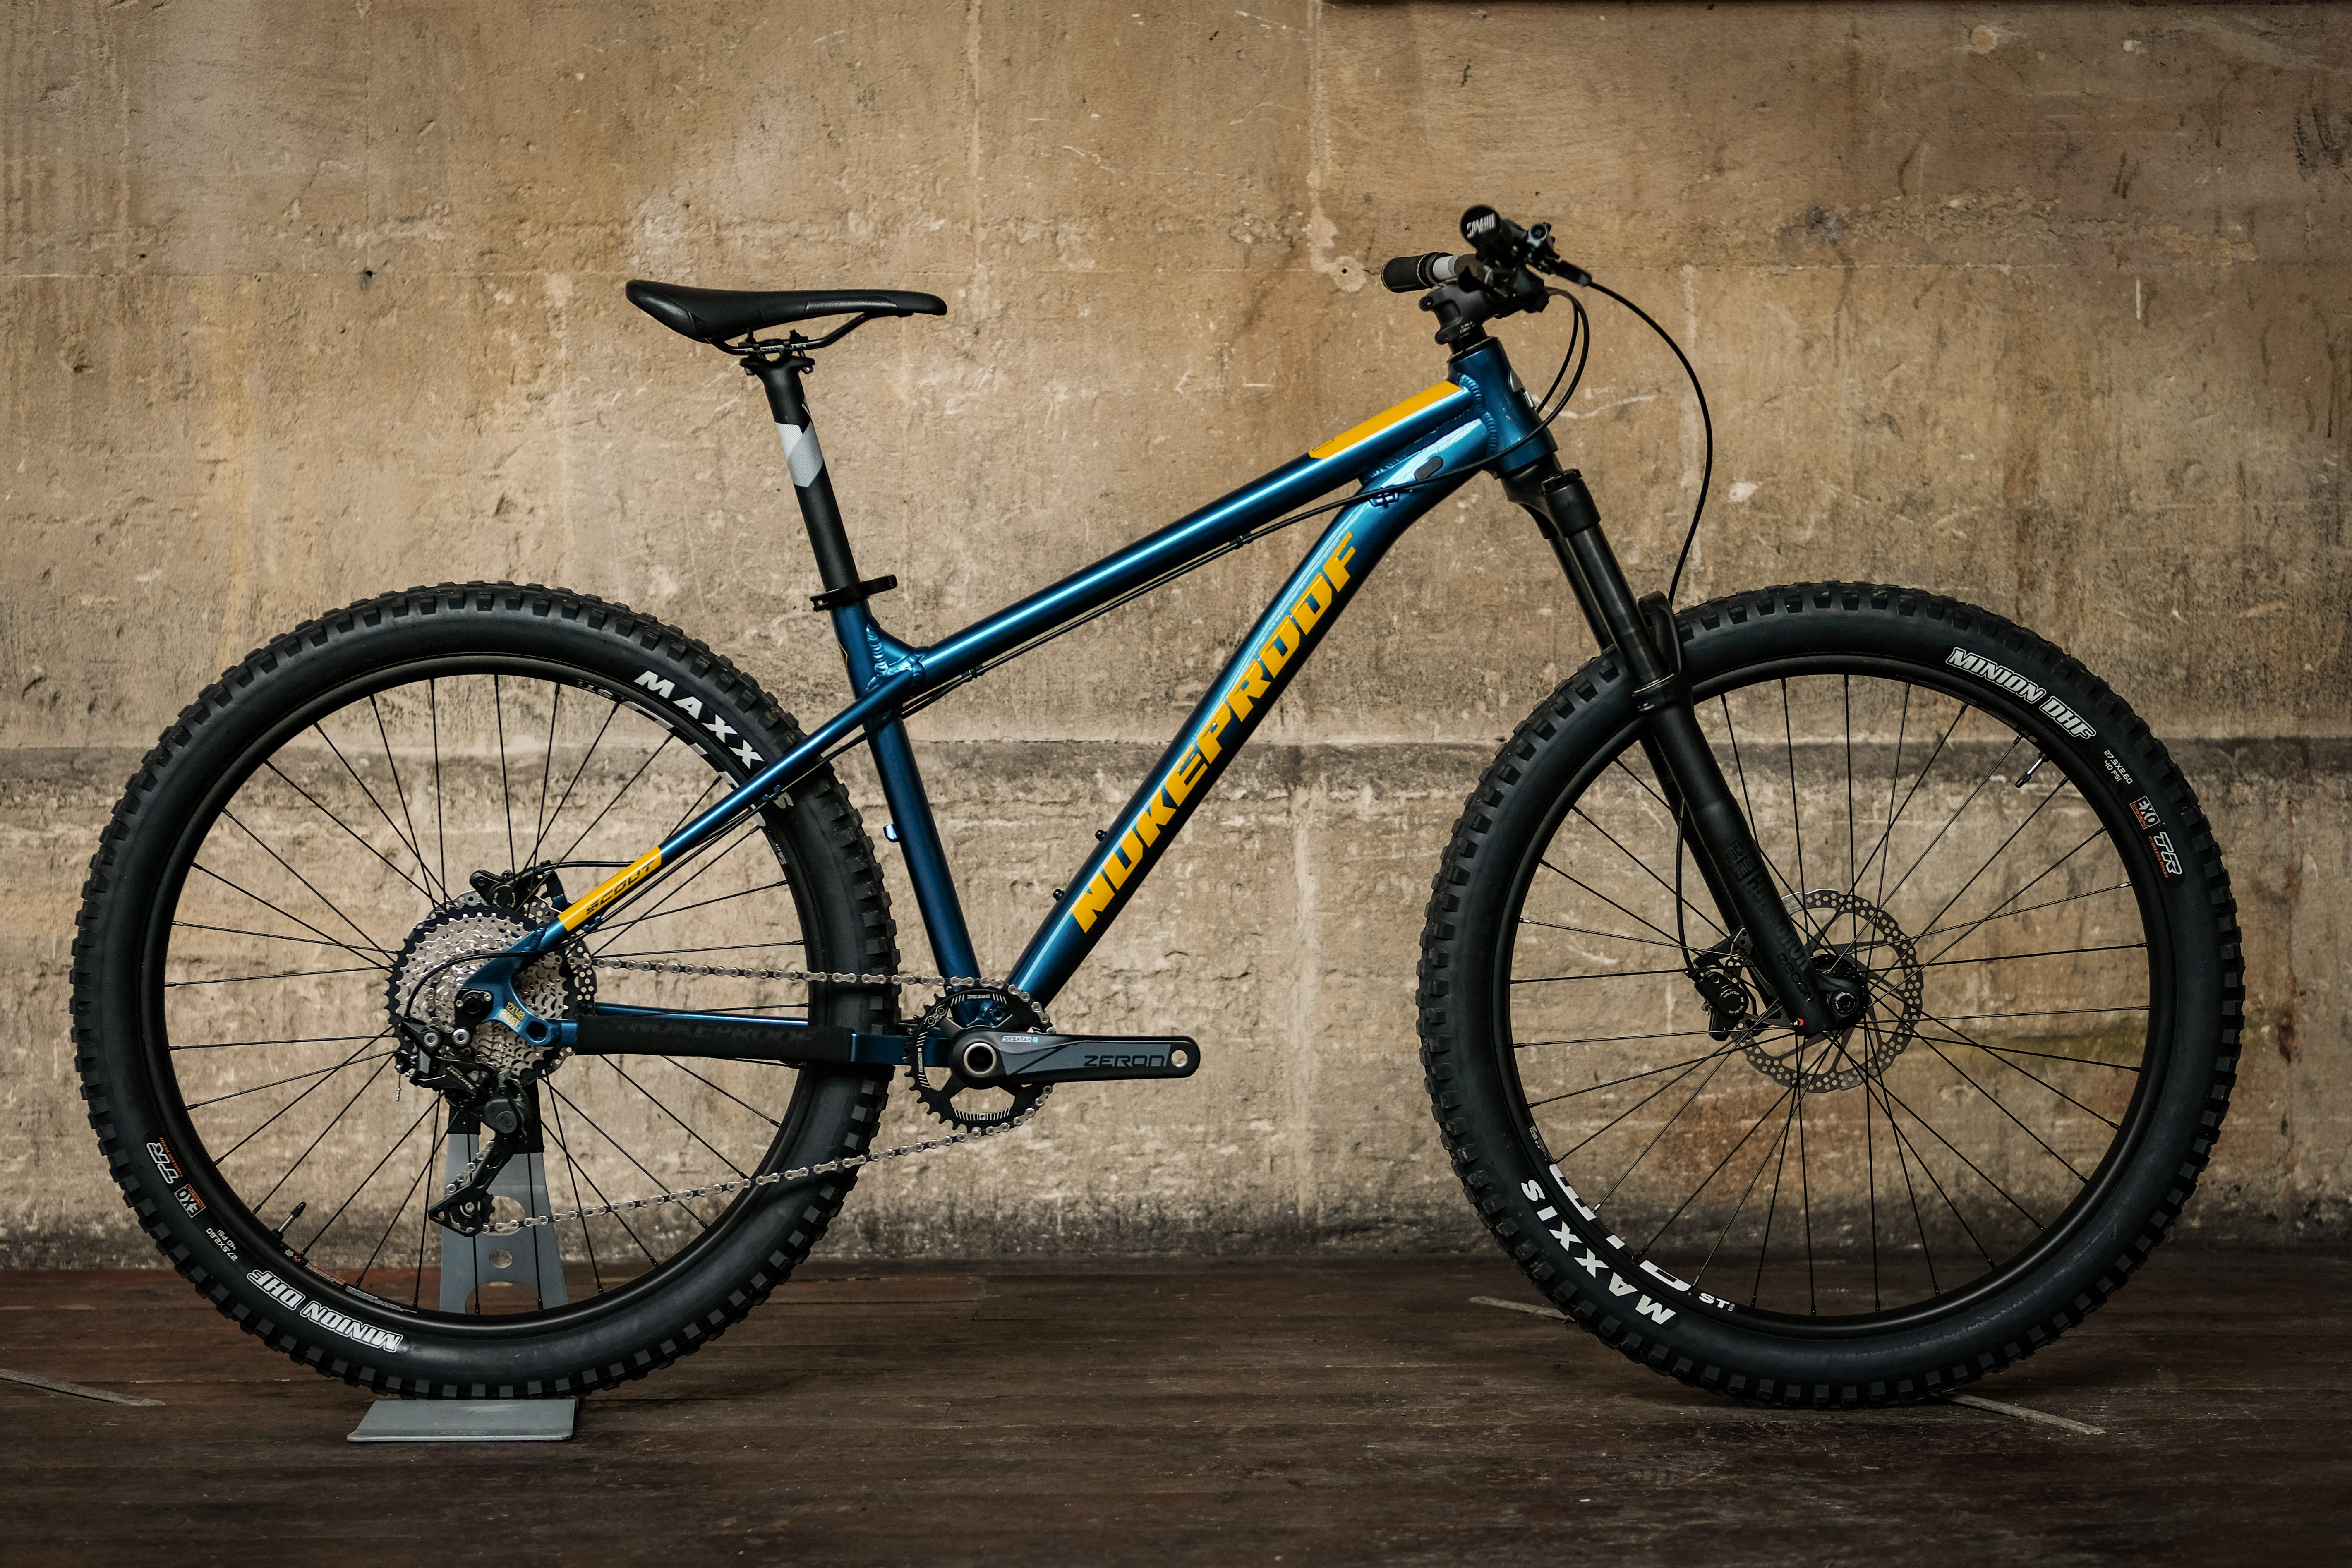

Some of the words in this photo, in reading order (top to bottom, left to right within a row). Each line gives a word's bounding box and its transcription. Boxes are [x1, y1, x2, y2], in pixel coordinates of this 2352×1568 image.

[1945, 646, 2047, 705] MINION
[2039, 695, 2097, 740] DHF
[1072, 531, 1356, 933] NUKEPROOF
[2103, 749, 2133, 784] 27.5X2.60
[2104, 760, 2113, 770] 40
[2111, 770, 2122, 782] PSI
[2137, 796, 2160, 824] EXO
[2153, 831, 2182, 875] TR
[585, 859, 655, 916] SCOUT
[501, 1009, 521, 1028] BOOST
[506, 1001, 525, 1020] 12X148
[1083, 1055, 1166, 1067] ZERON
[446, 1067, 475, 1090] DEORE
[146, 1142, 179, 1184] TR
[175, 1187, 199, 1216] EXO
[206, 1228, 238, 1261] 27.5X2.60
[217, 1229, 229, 1241] PSI
[226, 1240, 236, 1250] 40
[1520, 1179, 1677, 1325] MAXXIS
[246, 1269, 306, 1311] DHF
[1699, 1292, 1730, 1309] ST
[300, 1300, 403, 1353] MINION
